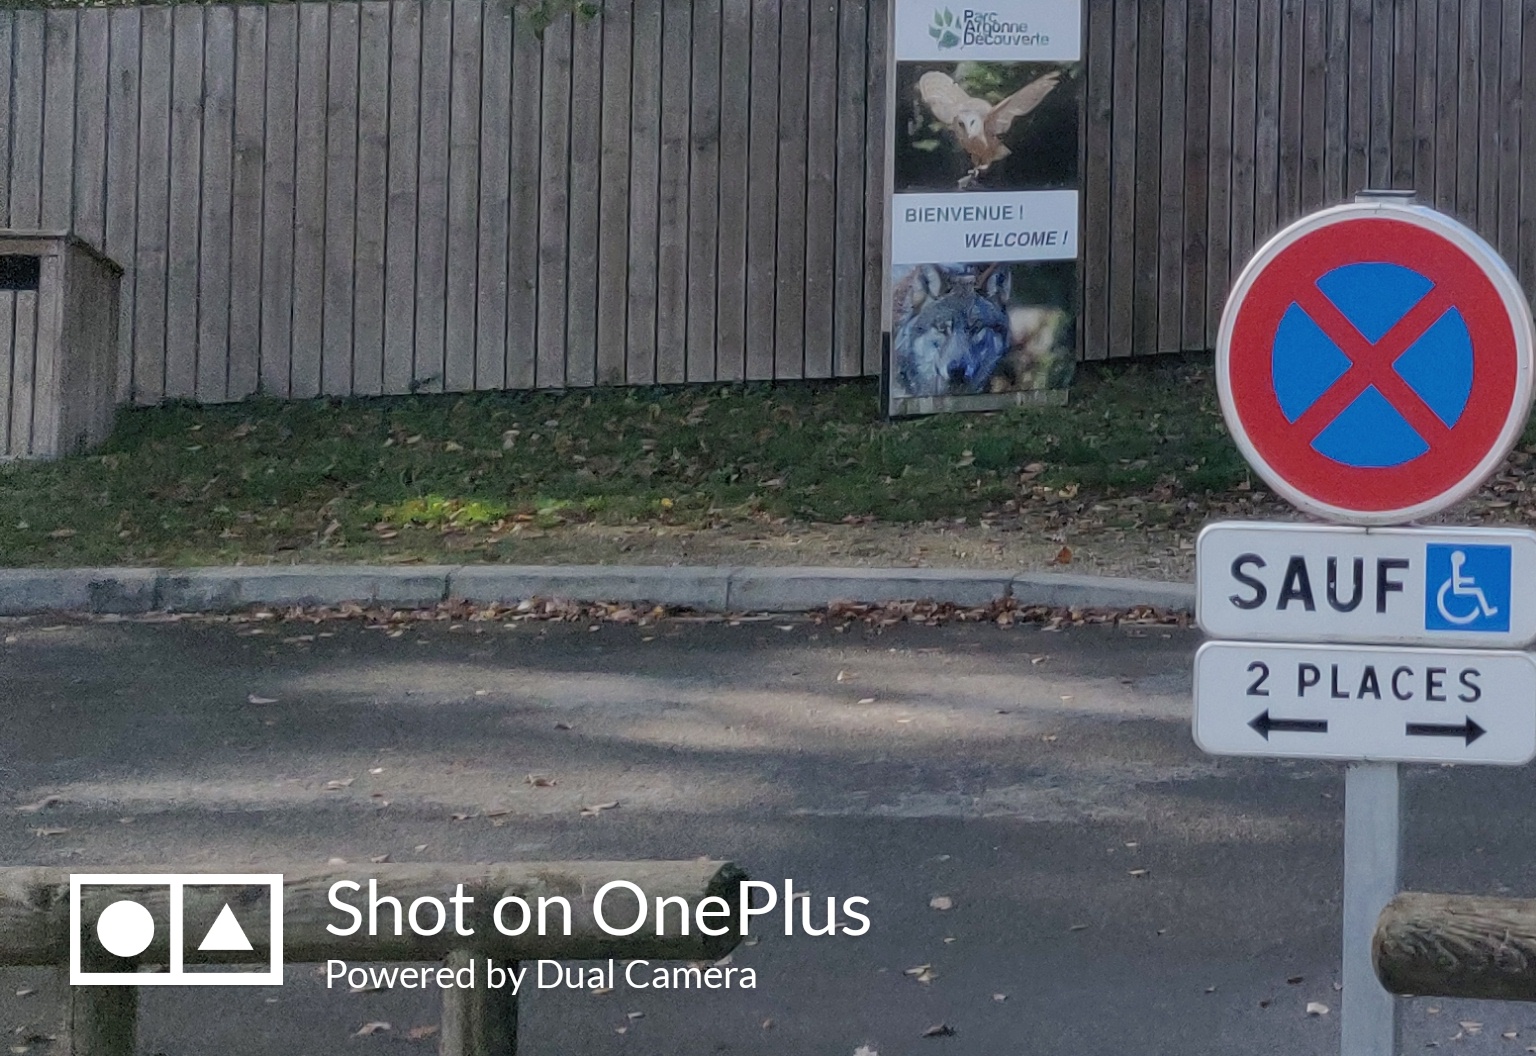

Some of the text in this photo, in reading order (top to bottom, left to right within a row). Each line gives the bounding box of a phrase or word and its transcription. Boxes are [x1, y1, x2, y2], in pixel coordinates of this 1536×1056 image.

[964, 9, 998, 23] Parc
[965, 19, 1028, 38] Argonne
[905, 205, 1014, 223] BIENVENUE
[965, 231, 1058, 248] WELCOME
[1228, 552, 1411, 615] SAUF
[1246, 661, 1483, 704] 2 PLACES
